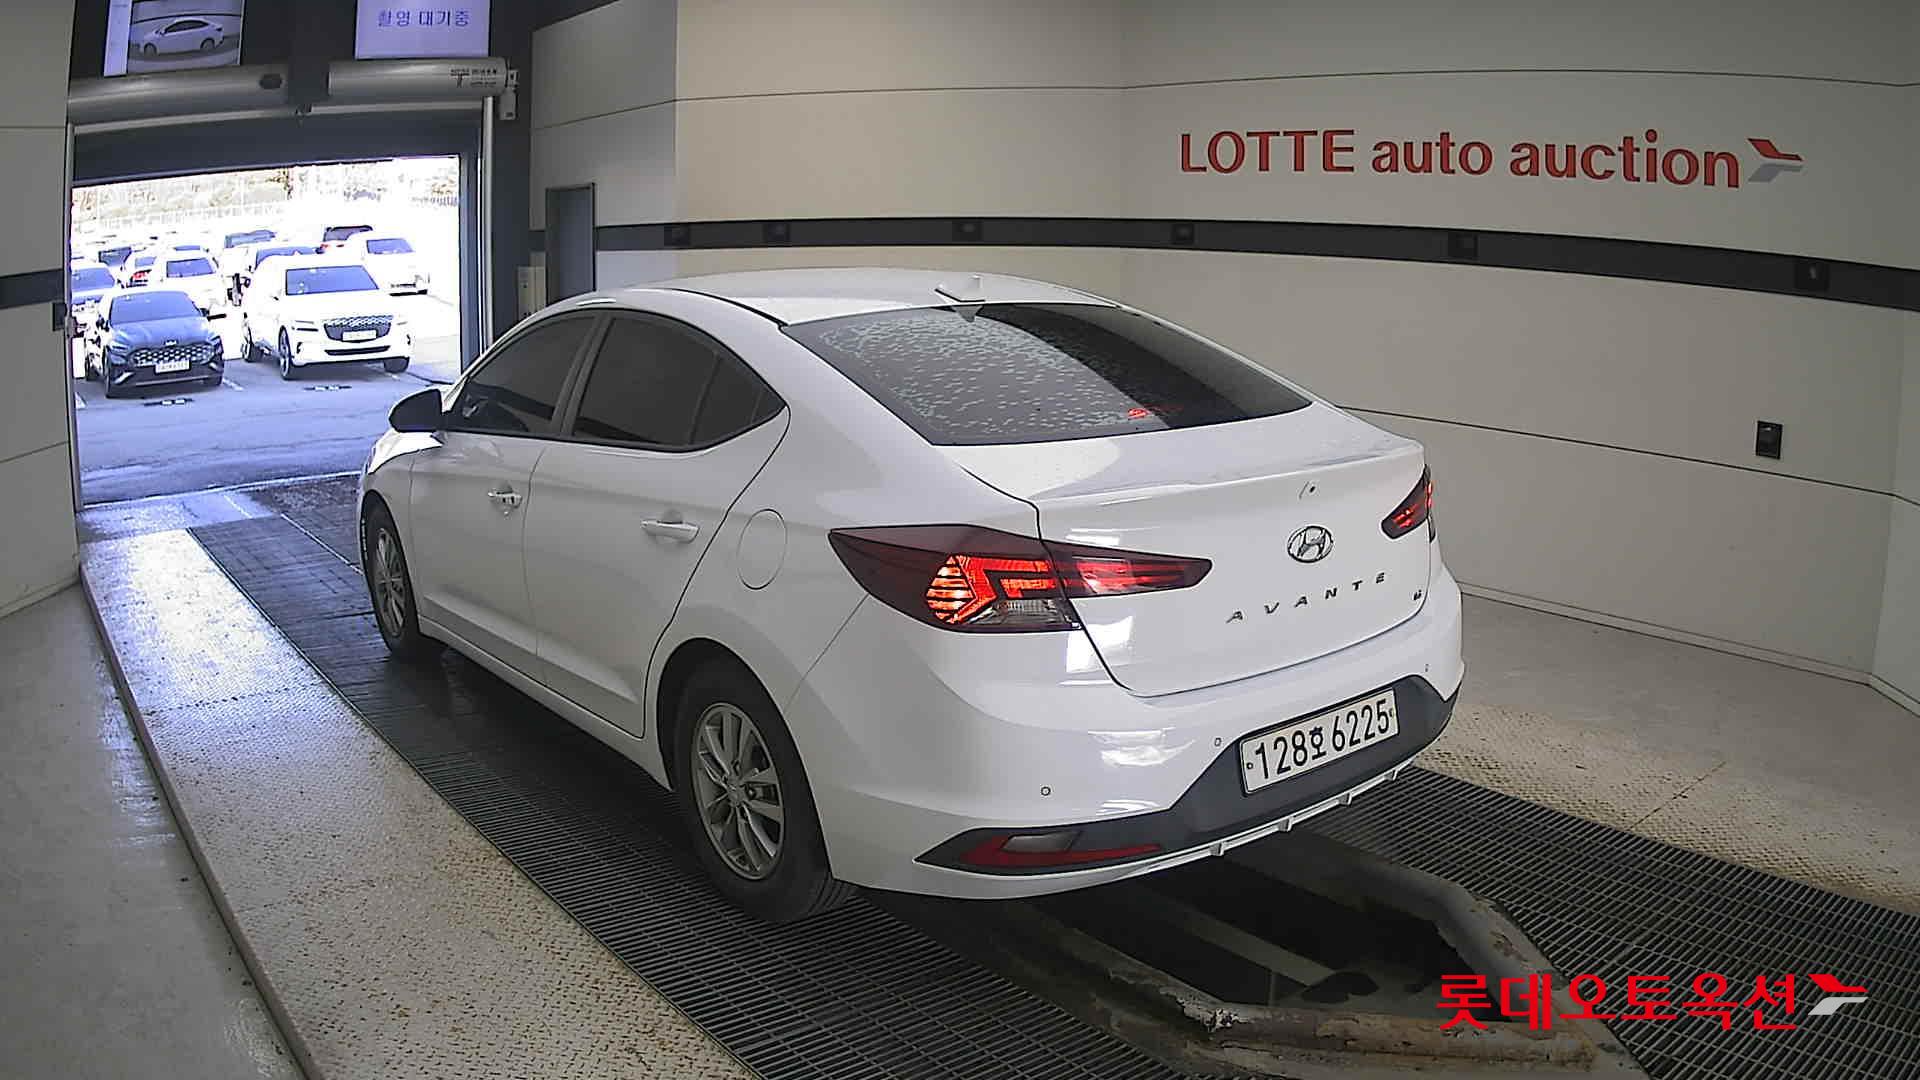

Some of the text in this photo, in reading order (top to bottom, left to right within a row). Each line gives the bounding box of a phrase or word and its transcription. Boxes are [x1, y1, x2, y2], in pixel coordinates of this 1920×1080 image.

[419, 10, 469, 27] 대기중
[1181, 129, 1740, 188] LOTTE auto auction
[1226, 572, 1385, 623] AVANTE
